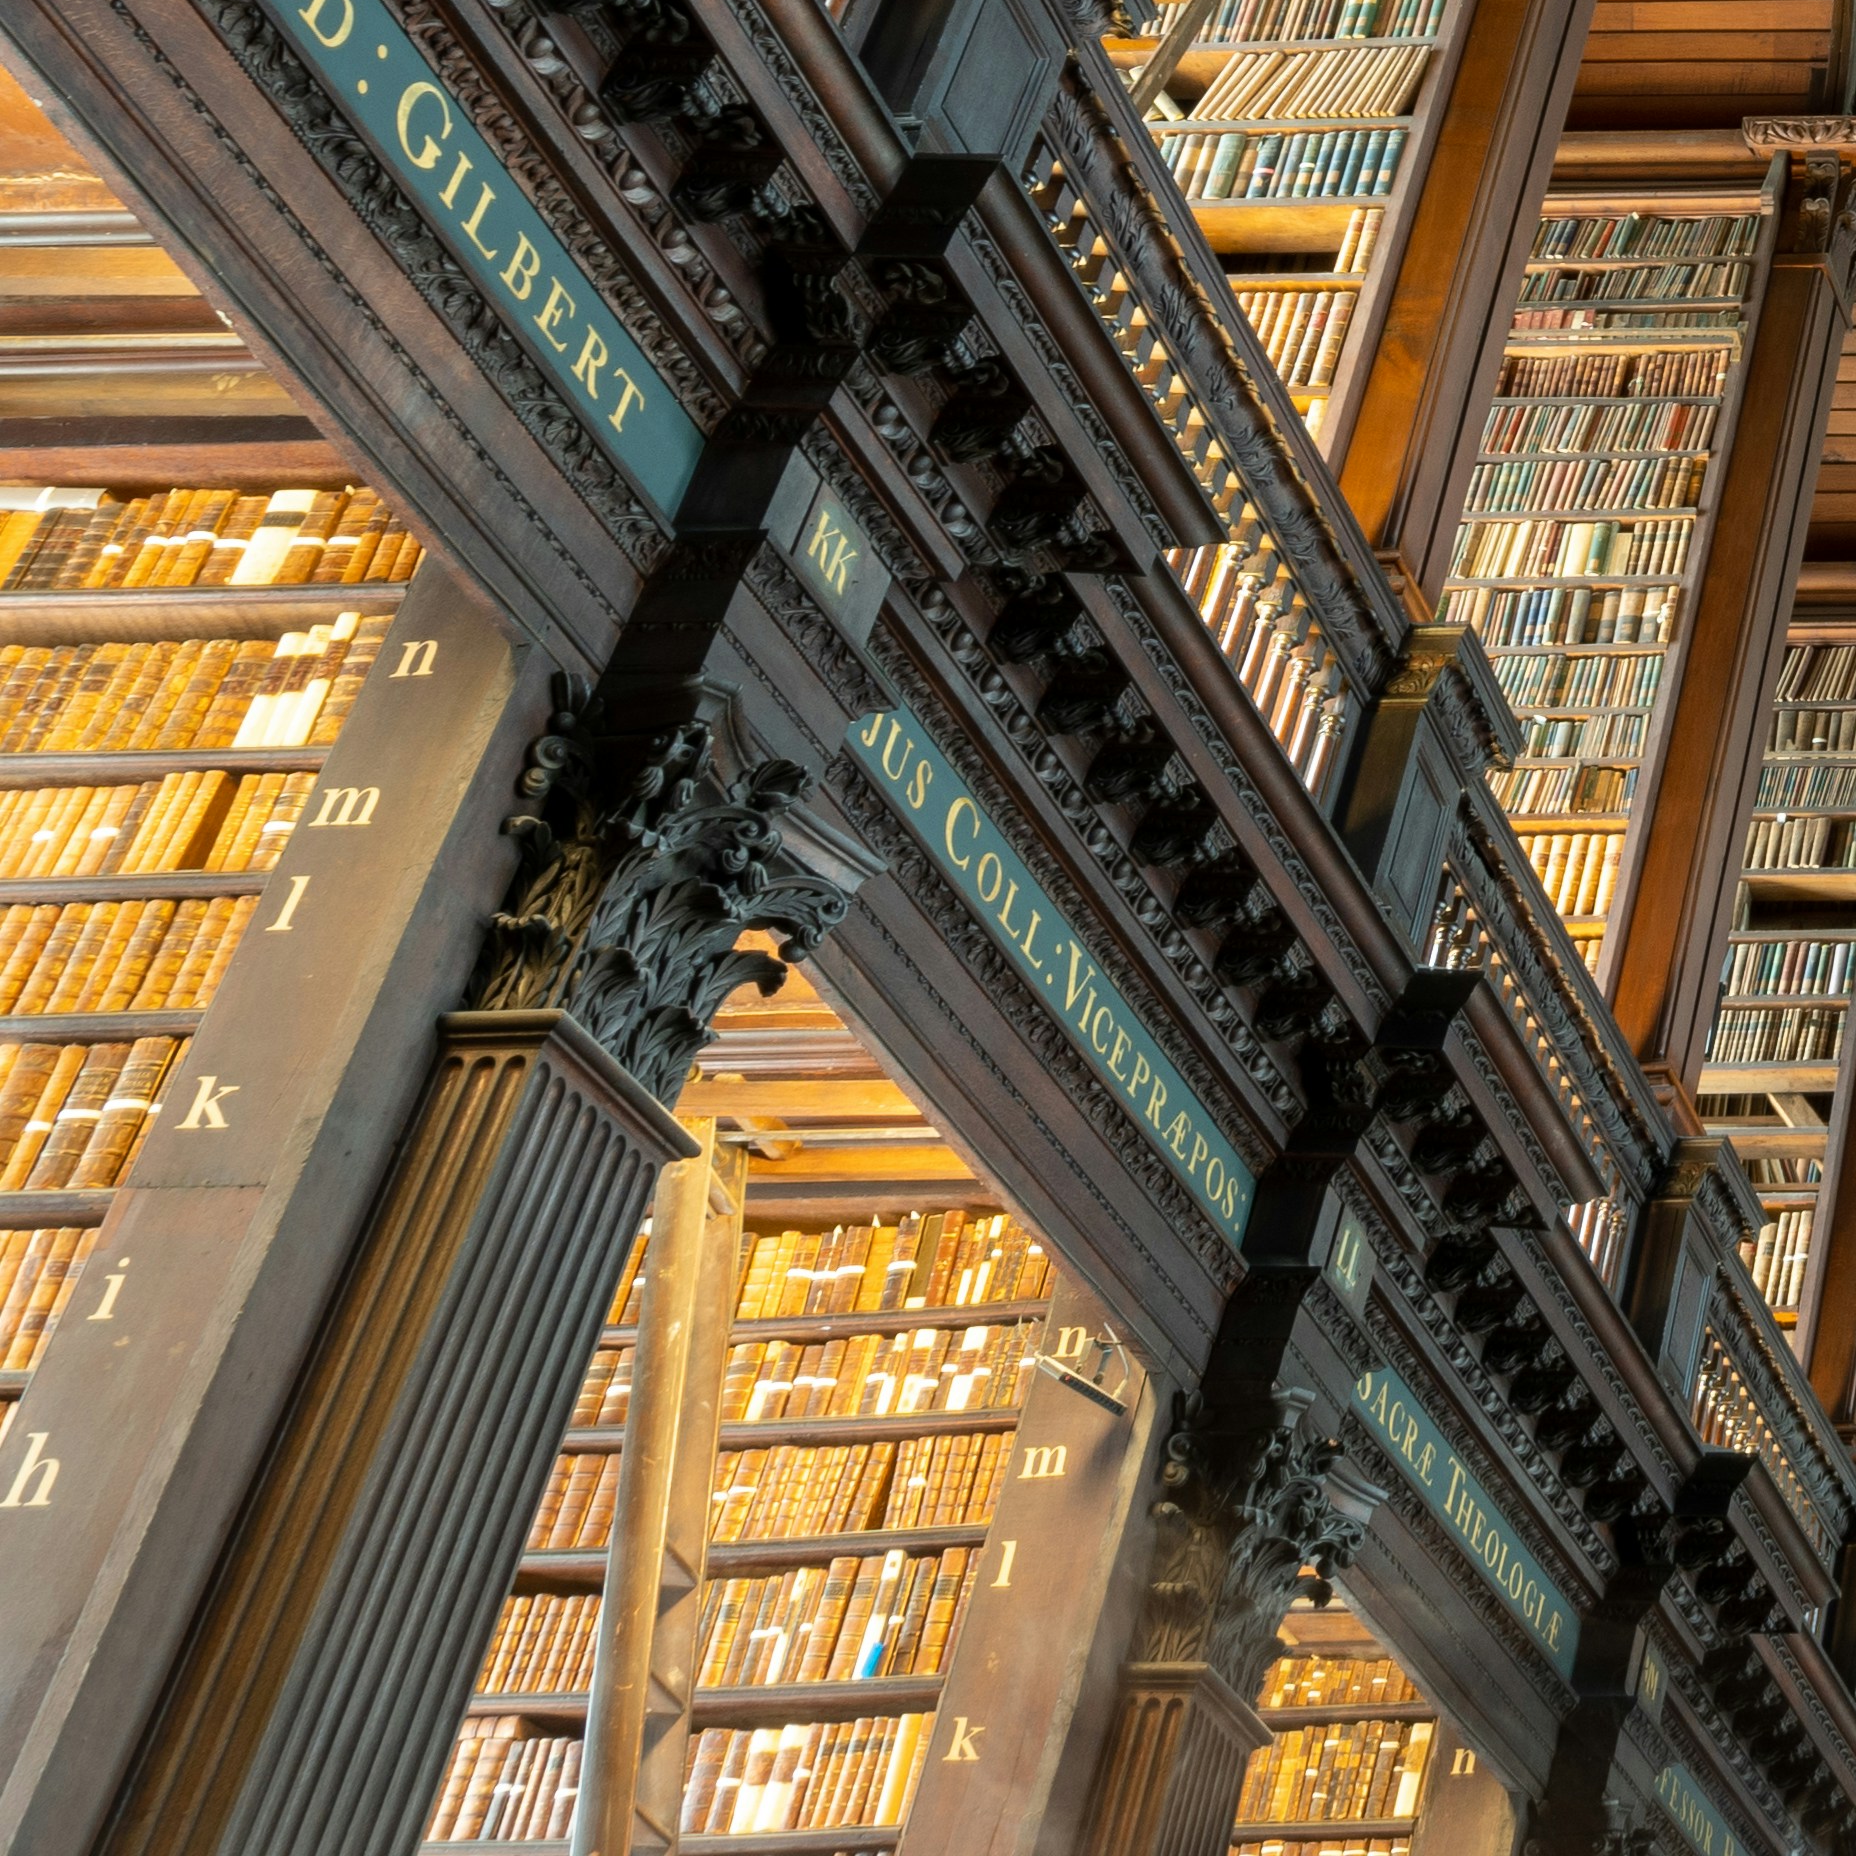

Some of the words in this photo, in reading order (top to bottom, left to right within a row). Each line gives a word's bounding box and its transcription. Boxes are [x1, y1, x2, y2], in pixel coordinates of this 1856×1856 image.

[397, 81, 645, 433] GILBERT
[807, 510, 858, 596] KK
[390, 640, 438, 677] n
[309, 783, 380, 827] m
[174, 1076, 241, 1130] k
[88, 1256, 131, 1321] i
[1052, 1326, 1087, 1358] n
[0, 1431, 60, 1508] h
[1018, 1442, 1068, 1479] m
[1443, 1456, 1564, 1653] THEOLOGIÆ
[942, 1716, 985, 1763] k
[1450, 1748, 1476, 1776] n
[1655, 1766, 1714, 1856] FESSOR
